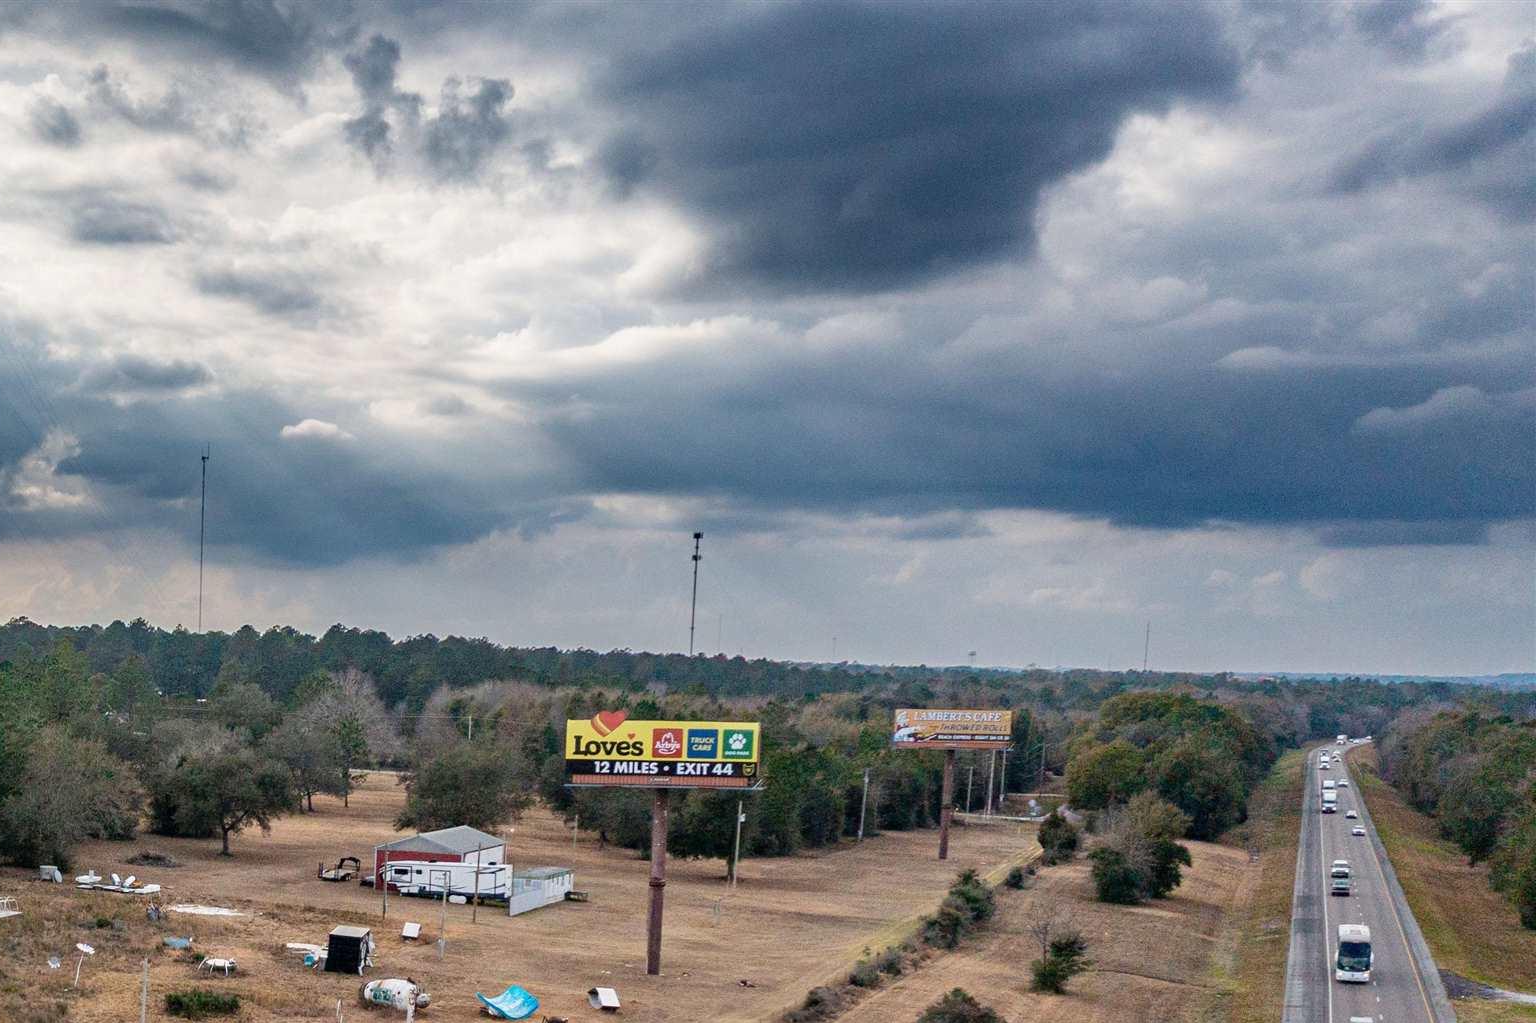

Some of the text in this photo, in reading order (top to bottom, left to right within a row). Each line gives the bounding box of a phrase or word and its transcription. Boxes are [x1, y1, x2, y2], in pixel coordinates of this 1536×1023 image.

[913, 711, 1002, 722] LAMBERT'S CAFE
[690, 736, 715, 744] TRUCK
[594, 761, 734, 776] 12 MILES EXIT 44
